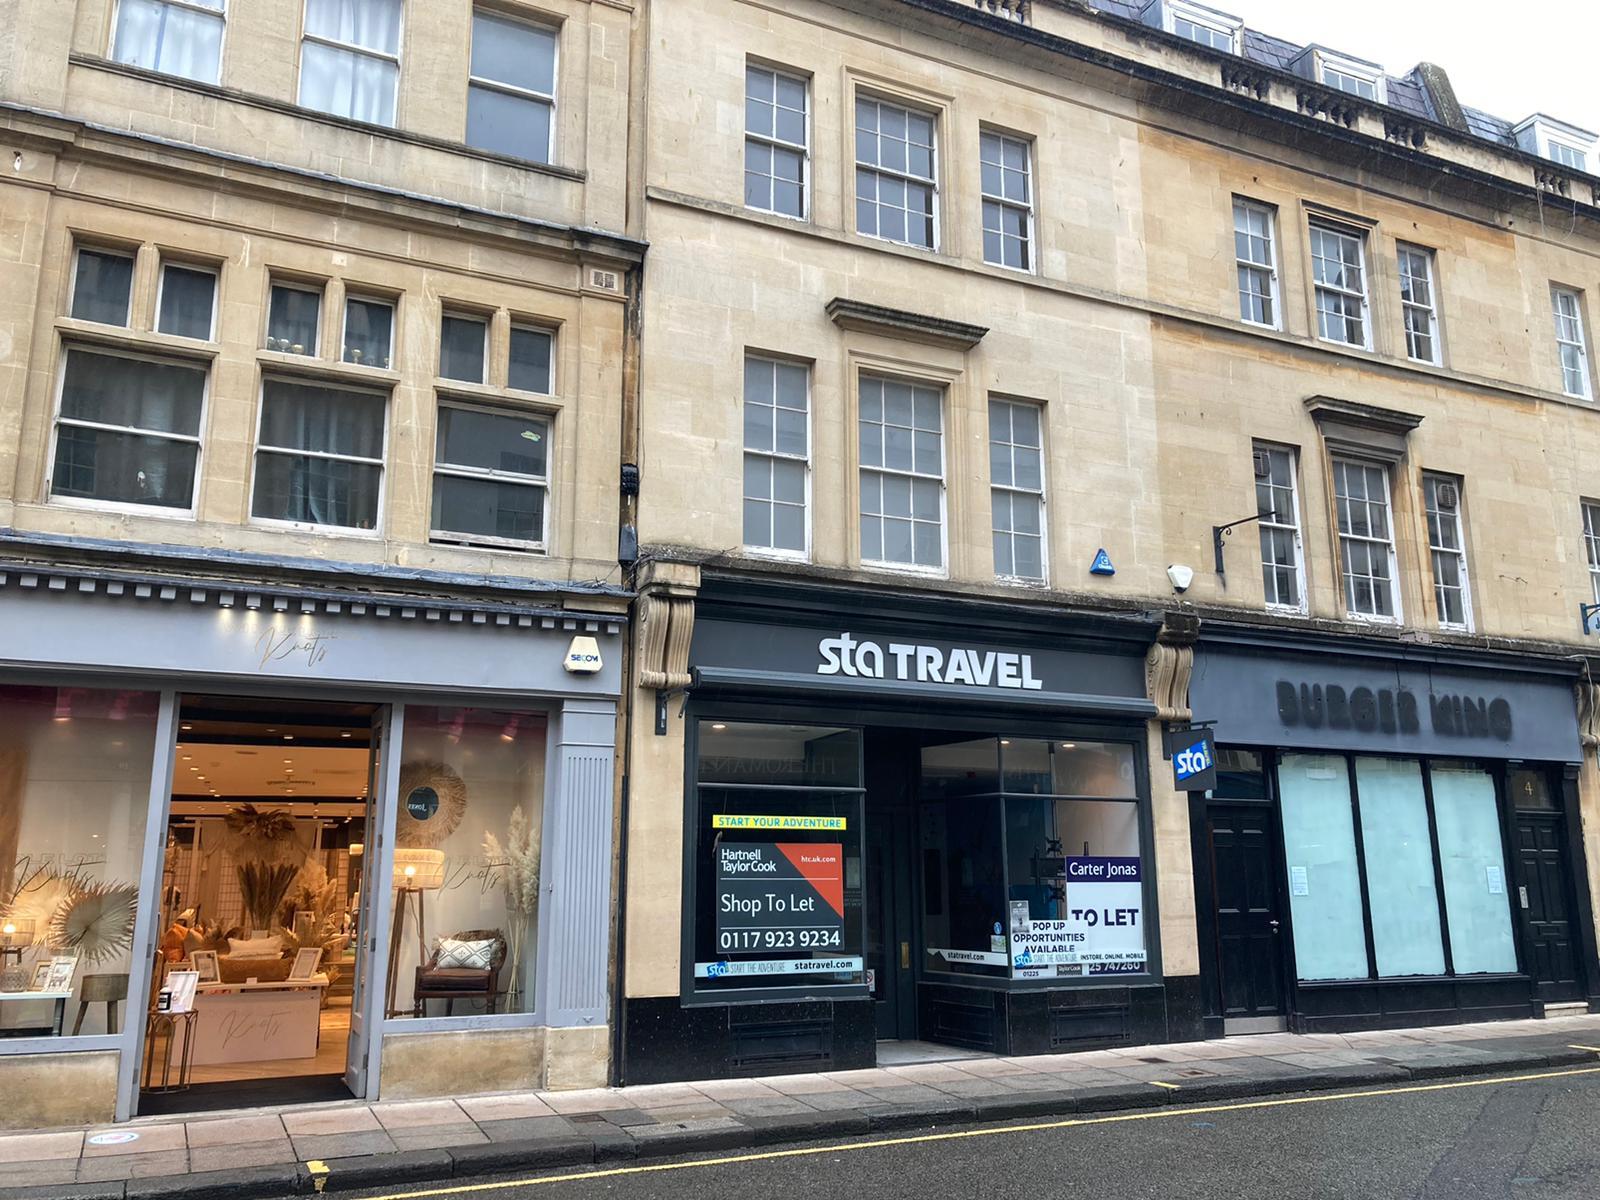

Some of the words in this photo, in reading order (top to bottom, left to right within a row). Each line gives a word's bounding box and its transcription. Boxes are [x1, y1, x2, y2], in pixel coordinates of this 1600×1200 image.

[571, 654, 599, 662] SECOM
[817, 632, 884, 678] sta
[889, 643, 1043, 690] TRAVEL
[1177, 748, 1207, 774] sta
[1525, 781, 1533, 796] 4
[719, 817, 749, 827] START
[754, 817, 780, 827] YOUR
[784, 818, 841, 828] ADVENTURE
[721, 848, 761, 861] Hartnell
[801, 855, 836, 863] htc.uk.com
[1069, 862, 1104, 876] Carter
[1106, 862, 1137, 878] Jonas
[720, 894, 762, 917] Shop
[765, 894, 785, 912] To
[790, 894, 815, 912] Let
[1071, 909, 1098, 927] TO
[1104, 909, 1139, 926] LET
[1032, 922, 1050, 931] POP
[1053, 922, 1066, 931] UP
[720, 932, 760, 948] 0117
[765, 931, 795, 948] 923
[799, 930, 841, 946] 9234
[1013, 933, 1085, 943] OPPORTUNITIES
[1025, 944, 1075, 954] AVAILABLE
[947, 952, 985, 961] statravel.com
[794, 959, 853, 970] statravel.com
